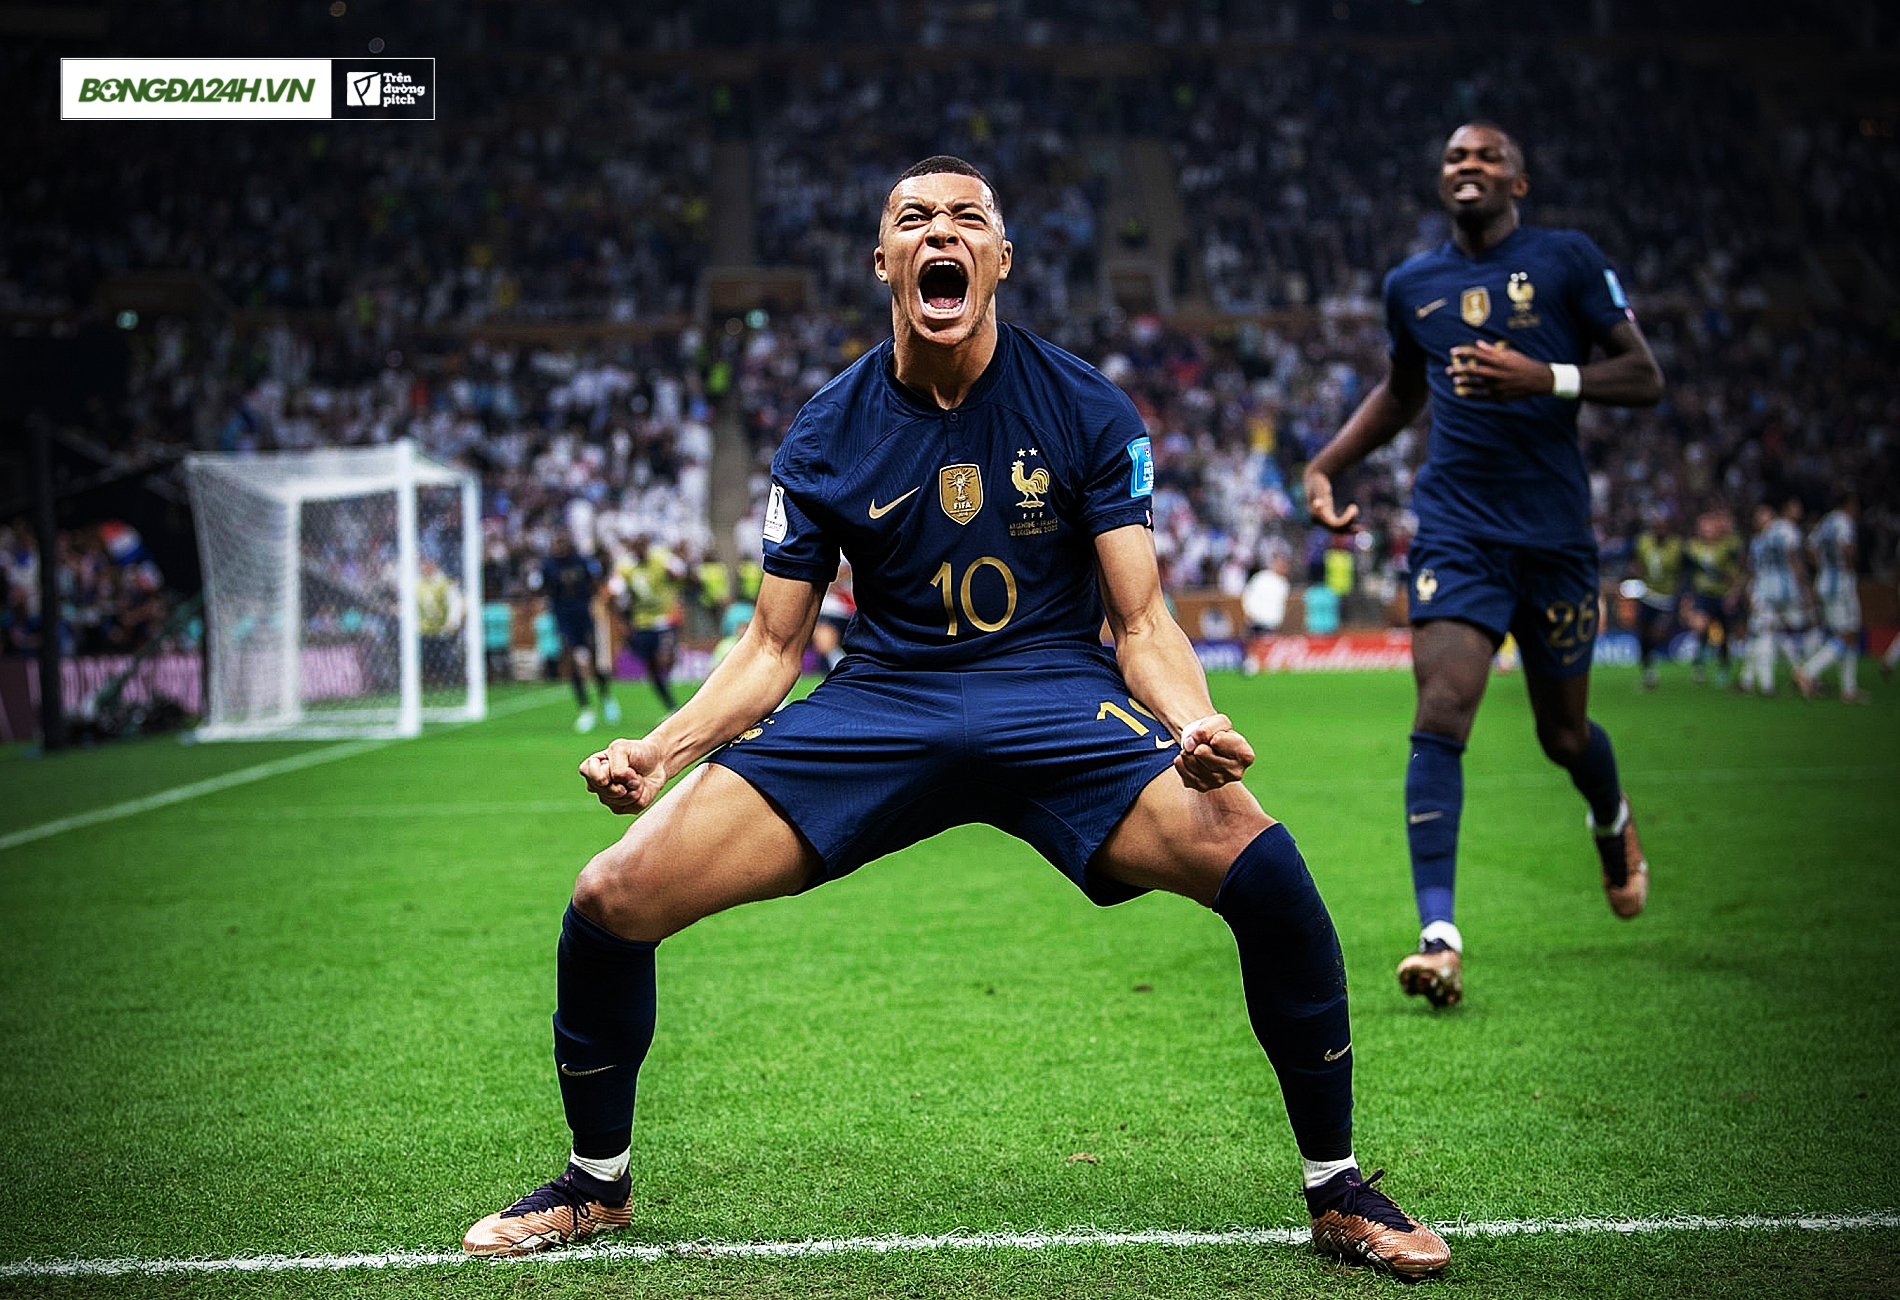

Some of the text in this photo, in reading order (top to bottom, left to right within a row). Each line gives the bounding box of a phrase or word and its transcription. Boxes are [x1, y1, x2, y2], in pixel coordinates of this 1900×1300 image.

[953, 501, 972, 510] FIFA
[929, 556, 1017, 636] 10
[1546, 592, 1595, 647] 26
